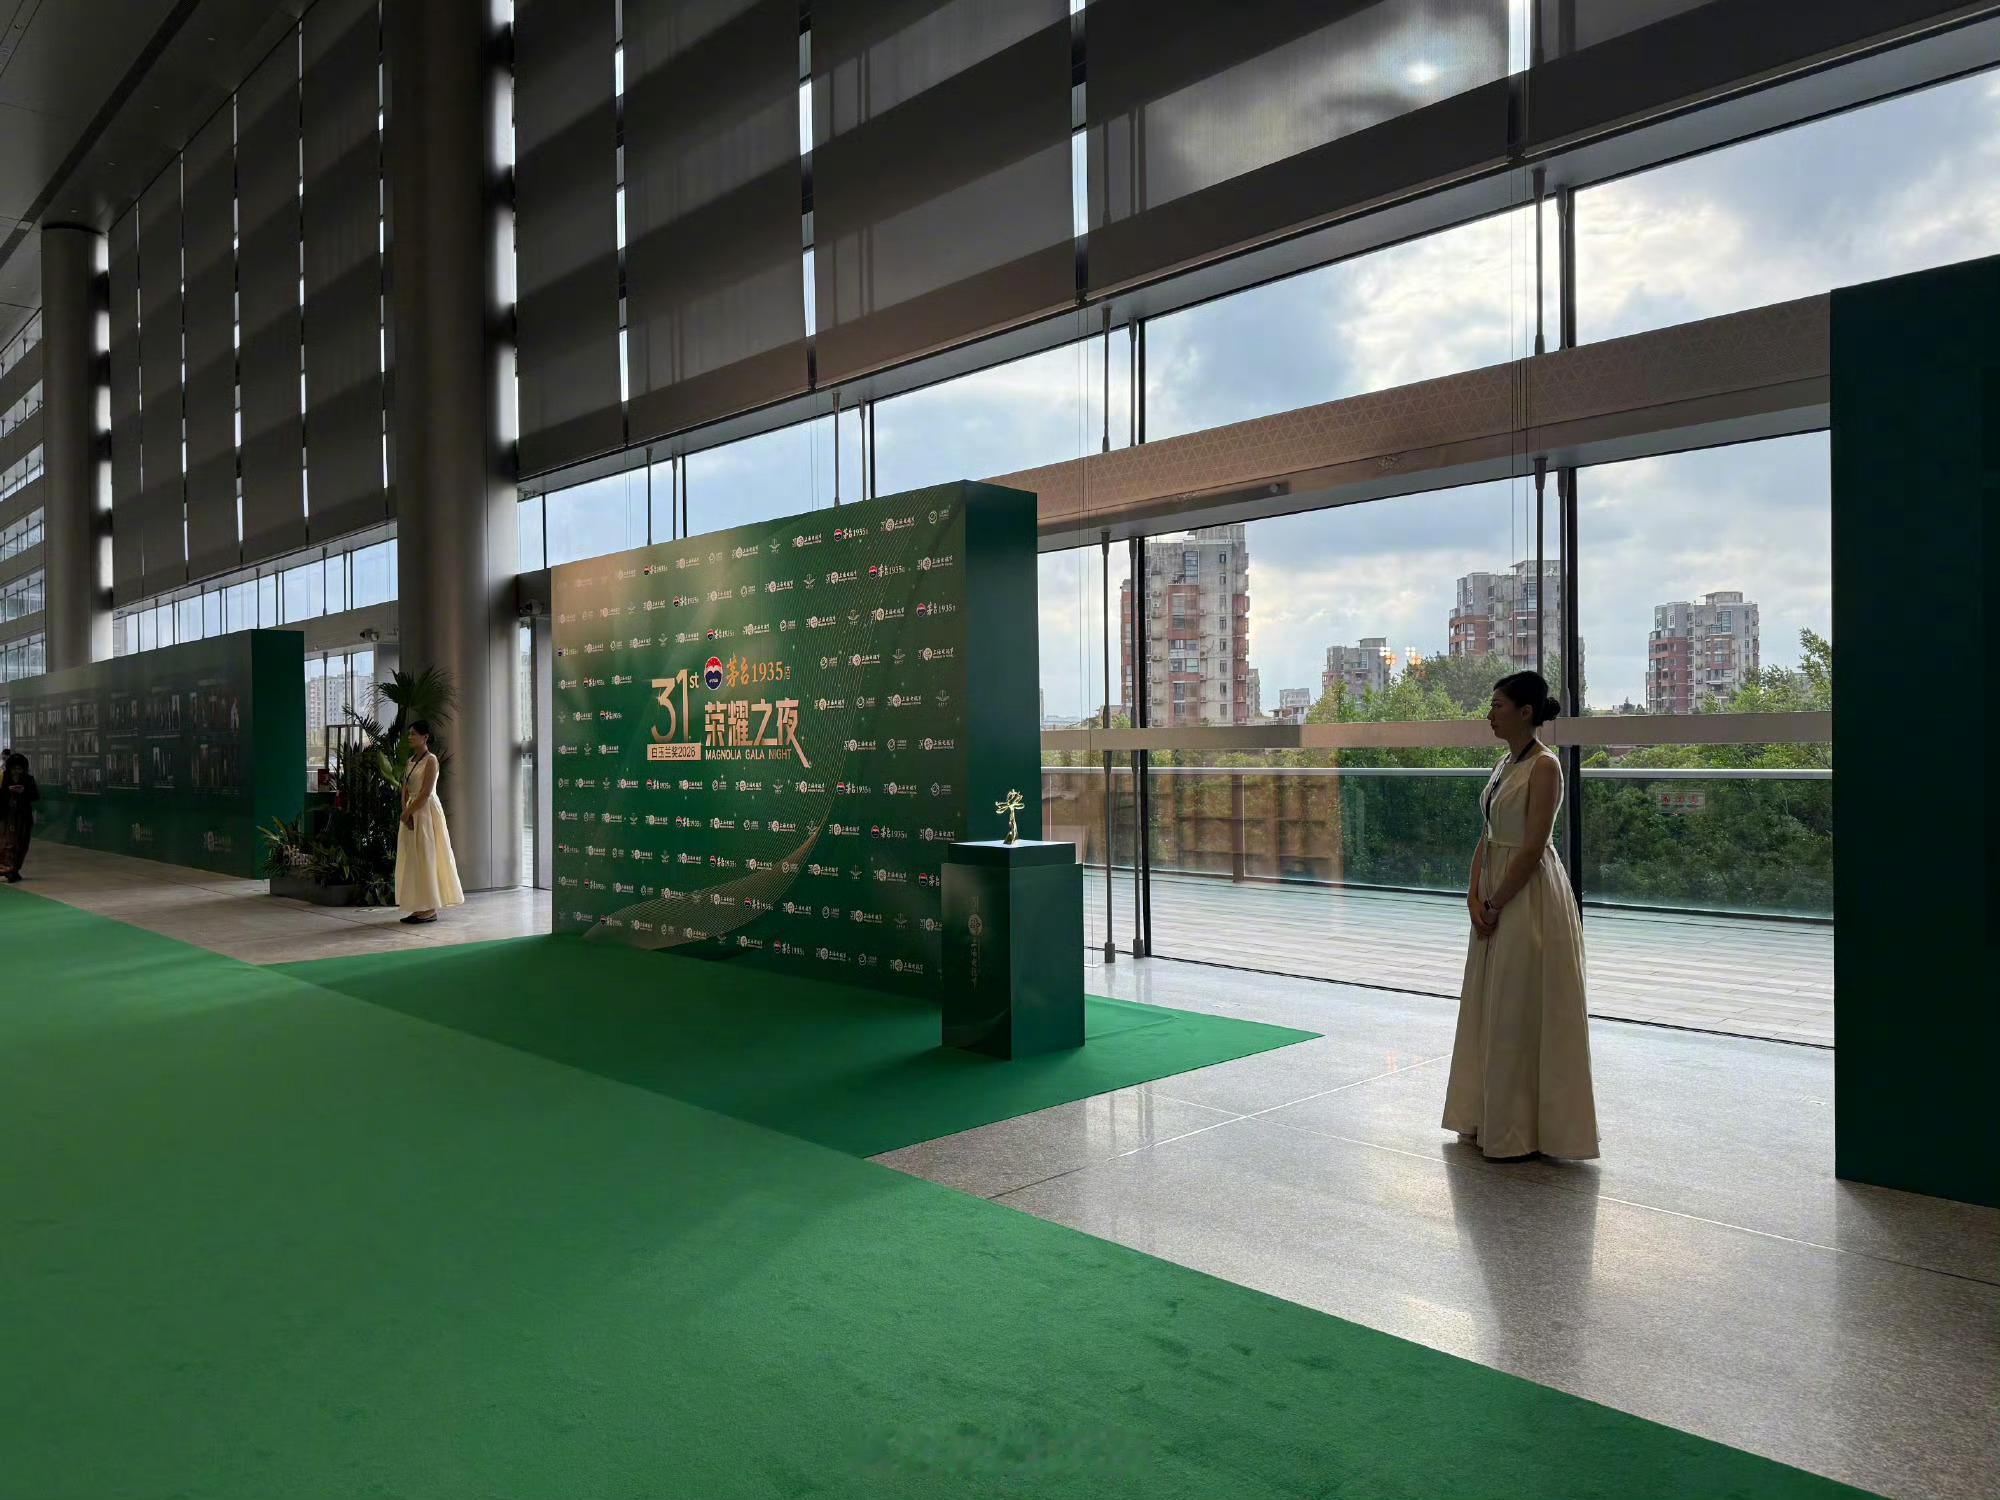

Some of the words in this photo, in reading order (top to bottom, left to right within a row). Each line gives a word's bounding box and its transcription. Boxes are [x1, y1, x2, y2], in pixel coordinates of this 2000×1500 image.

[704, 697, 810, 768] 荣耀之夜
[706, 750, 742, 760] MAGNOLIA
[746, 750, 764, 760] GALA
[769, 749, 791, 760] NIGHT
